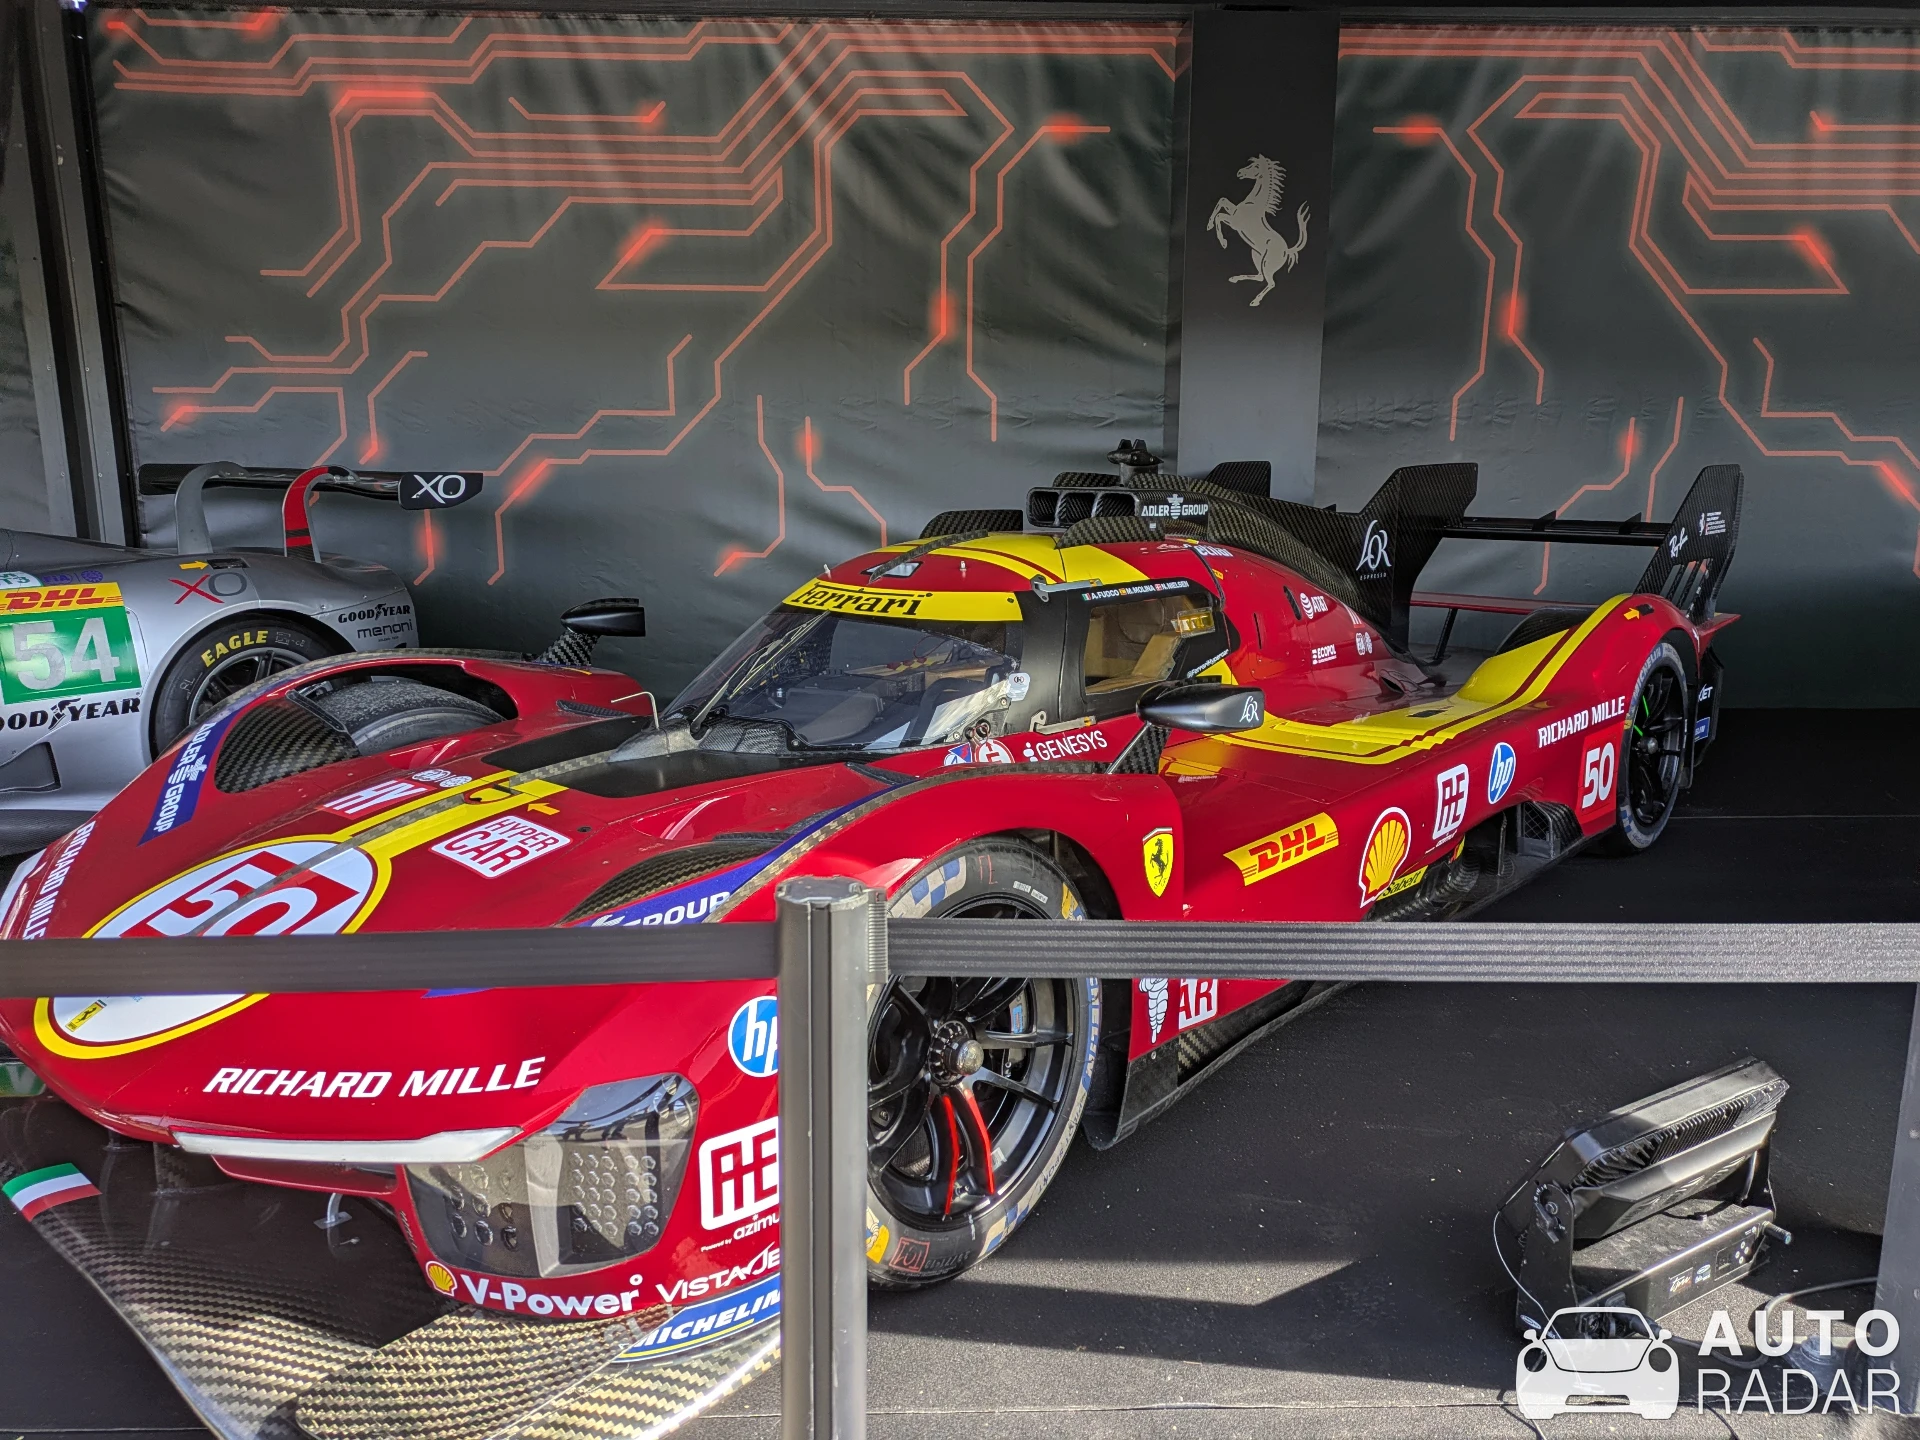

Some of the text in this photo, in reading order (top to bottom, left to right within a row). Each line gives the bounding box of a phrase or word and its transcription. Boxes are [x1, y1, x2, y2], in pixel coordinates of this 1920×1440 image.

[411, 474, 466, 504] XO
[1141, 504, 1209, 517] ADLER GROUP
[4, 587, 105, 611] DHL
[168, 571, 248, 605] XO
[791, 582, 934, 616] Ferrari
[12, 617, 121, 690] 54
[201, 630, 269, 668] EAGLE
[1317, 644, 1337, 659] ECOPOL
[1538, 695, 1626, 749] RICHARD MILLE
[1036, 730, 1108, 761] GENESYS
[153, 721, 218, 832] ADLER GROUP
[1490, 743, 1514, 804] hp
[1582, 742, 1615, 810] 50
[444, 830, 541, 873] CAR
[494, 818, 561, 854] HYPER
[1249, 822, 1327, 873] DHL
[40, 820, 97, 895] RICHARD
[622, 891, 731, 927] ROUP
[1179, 978, 1213, 1020] AR
[201, 1056, 546, 1099] RICHARD MILLE
[655, 1241, 780, 1303] VISTAJE
